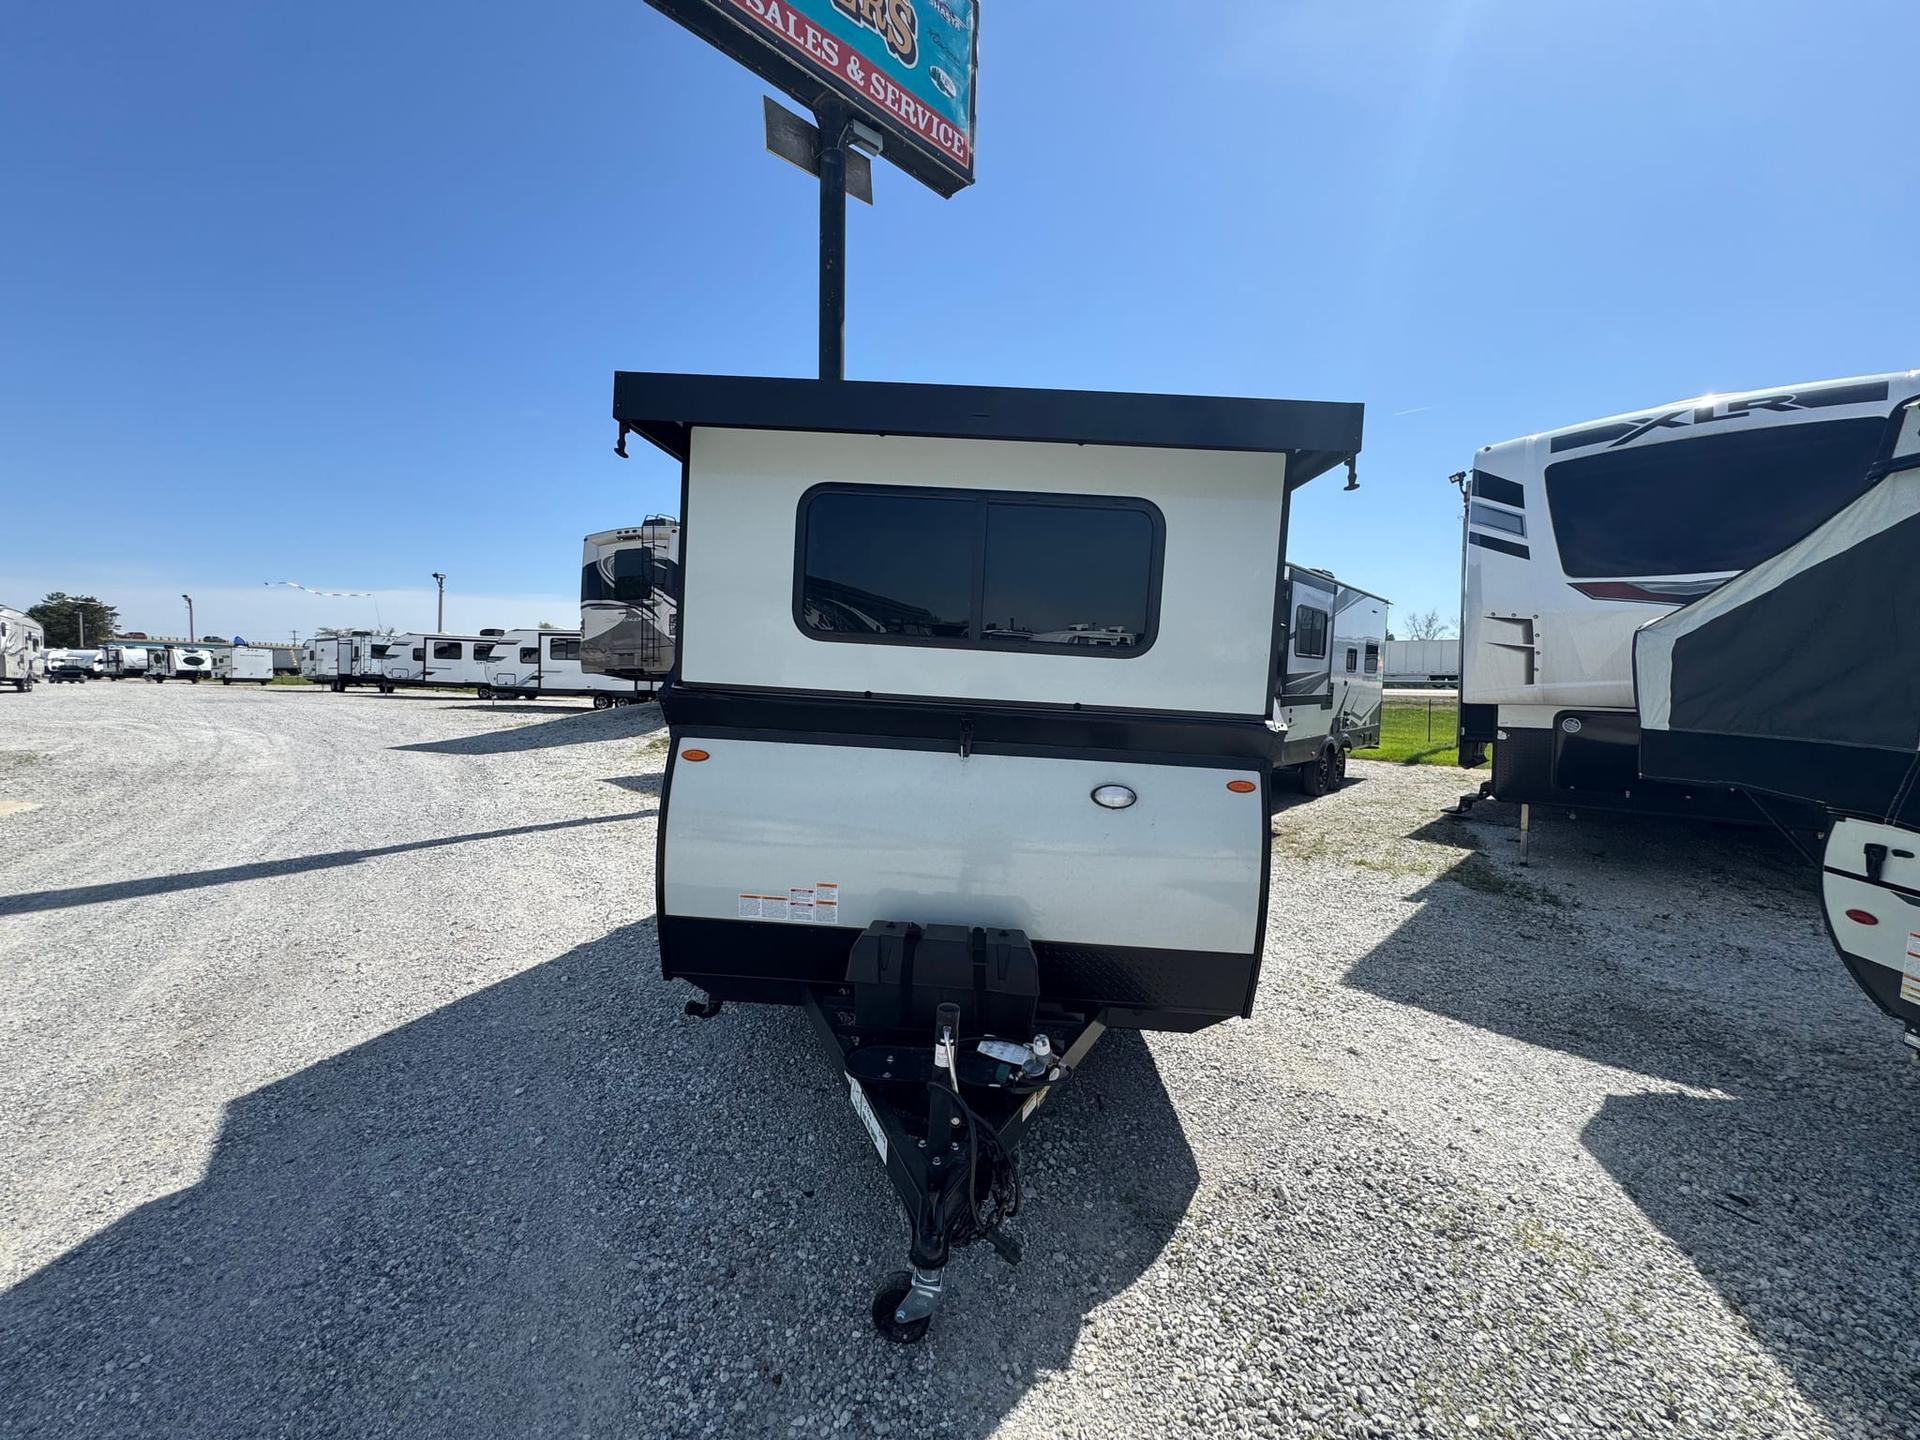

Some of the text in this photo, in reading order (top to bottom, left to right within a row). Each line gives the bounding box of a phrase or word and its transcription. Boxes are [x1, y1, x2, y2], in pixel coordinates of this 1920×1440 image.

[836, 0, 915, 58] RS
[746, 0, 964, 158] SALES & SERVICE
[1607, 394, 1804, 448] XLR
